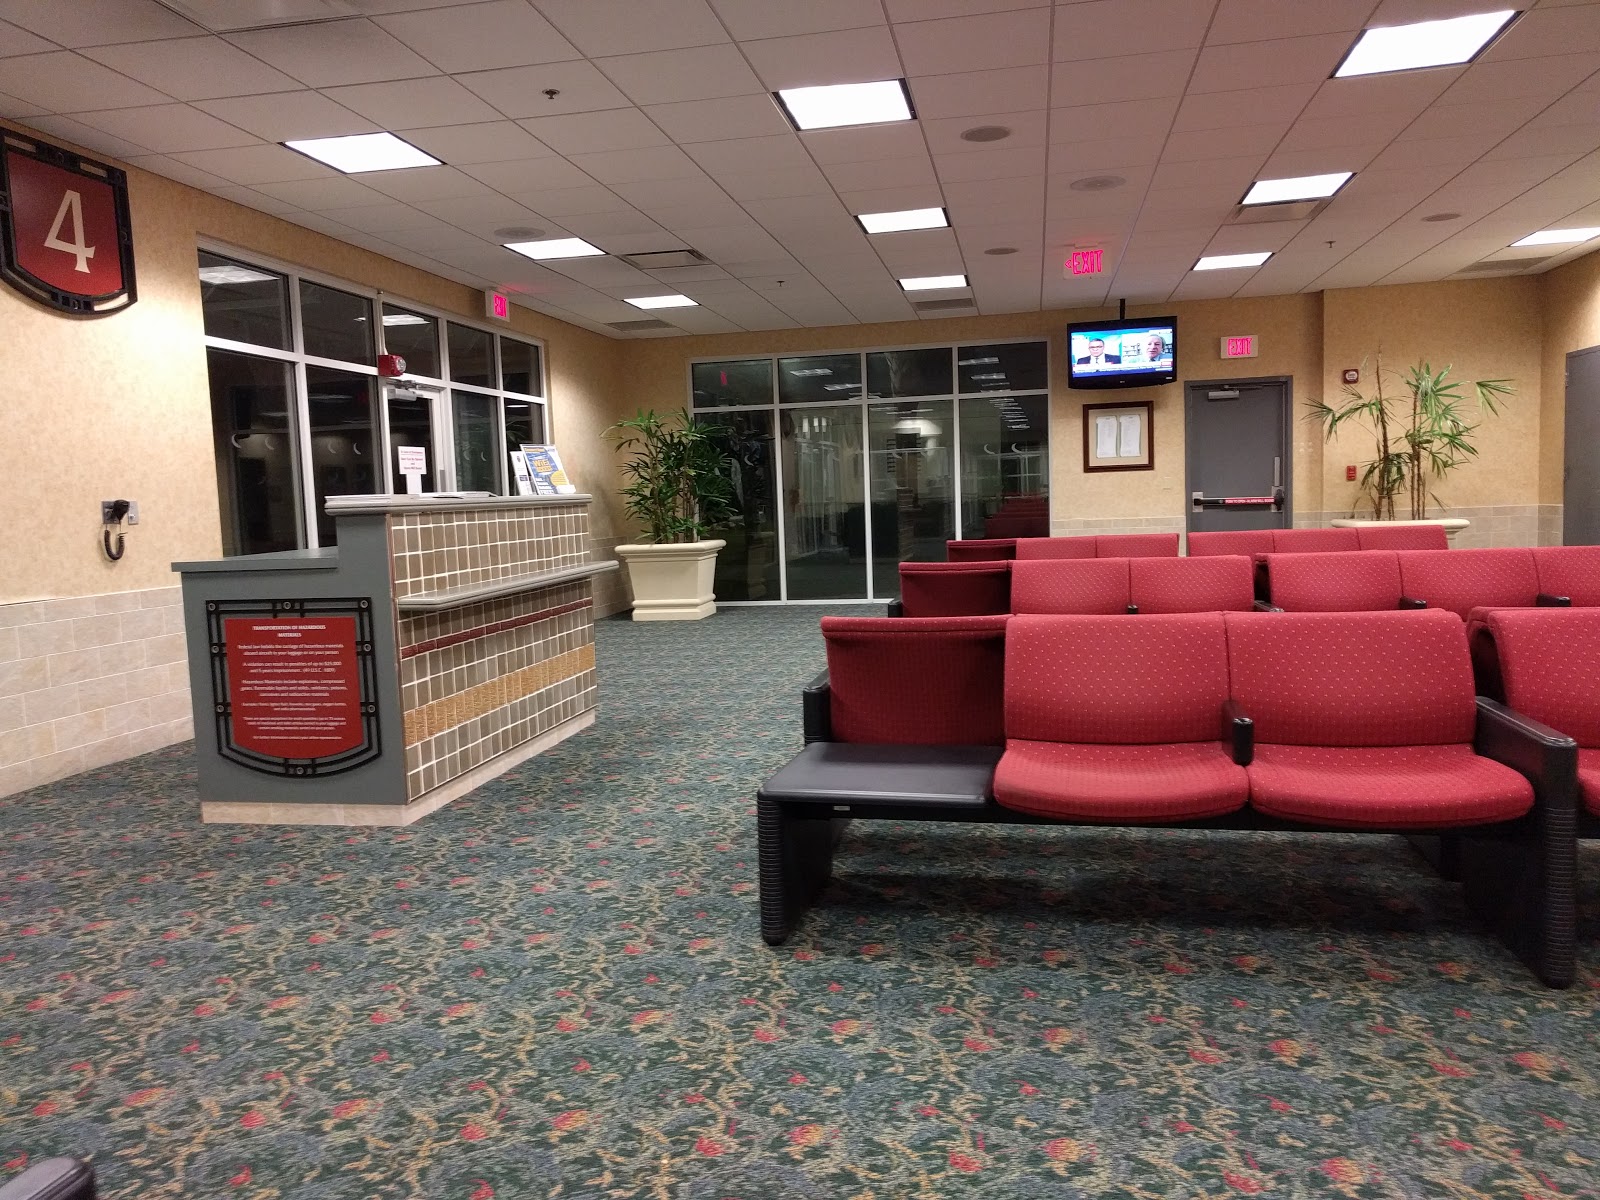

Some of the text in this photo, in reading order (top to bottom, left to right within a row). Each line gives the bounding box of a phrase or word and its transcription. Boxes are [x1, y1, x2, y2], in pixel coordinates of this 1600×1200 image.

[44, 189, 96, 274] 4
[1072, 249, 1104, 275] EXIT
[1227, 337, 1253, 356] EXIT
